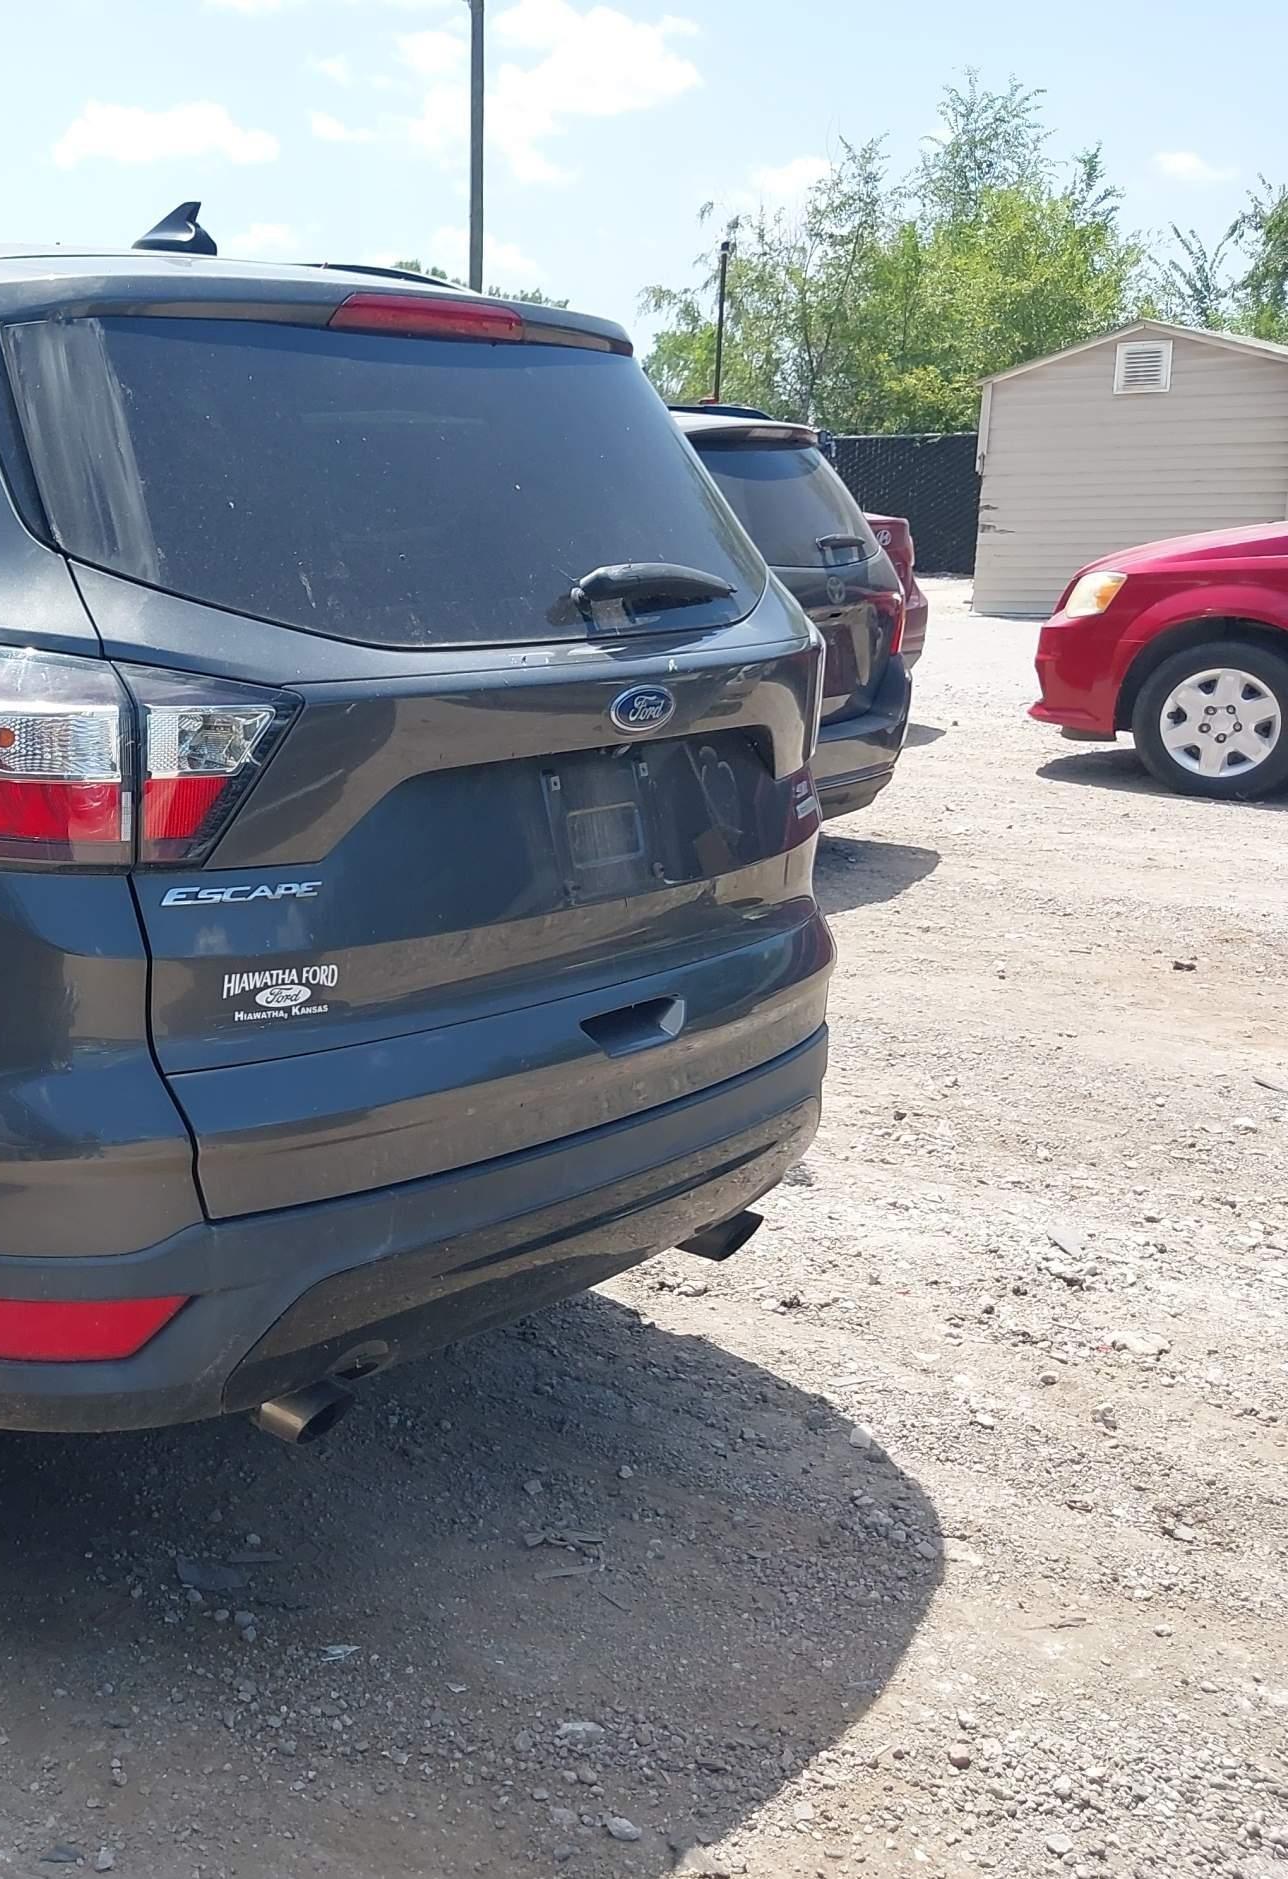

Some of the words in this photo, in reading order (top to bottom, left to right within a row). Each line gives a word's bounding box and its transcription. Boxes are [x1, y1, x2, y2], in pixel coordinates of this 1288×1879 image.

[629, 695, 665, 721] Ford
[161, 881, 323, 907] ESCAPE
[222, 967, 299, 999] HIAWATHA
[301, 964, 338, 987] FORD
[264, 987, 303, 1005] Ford
